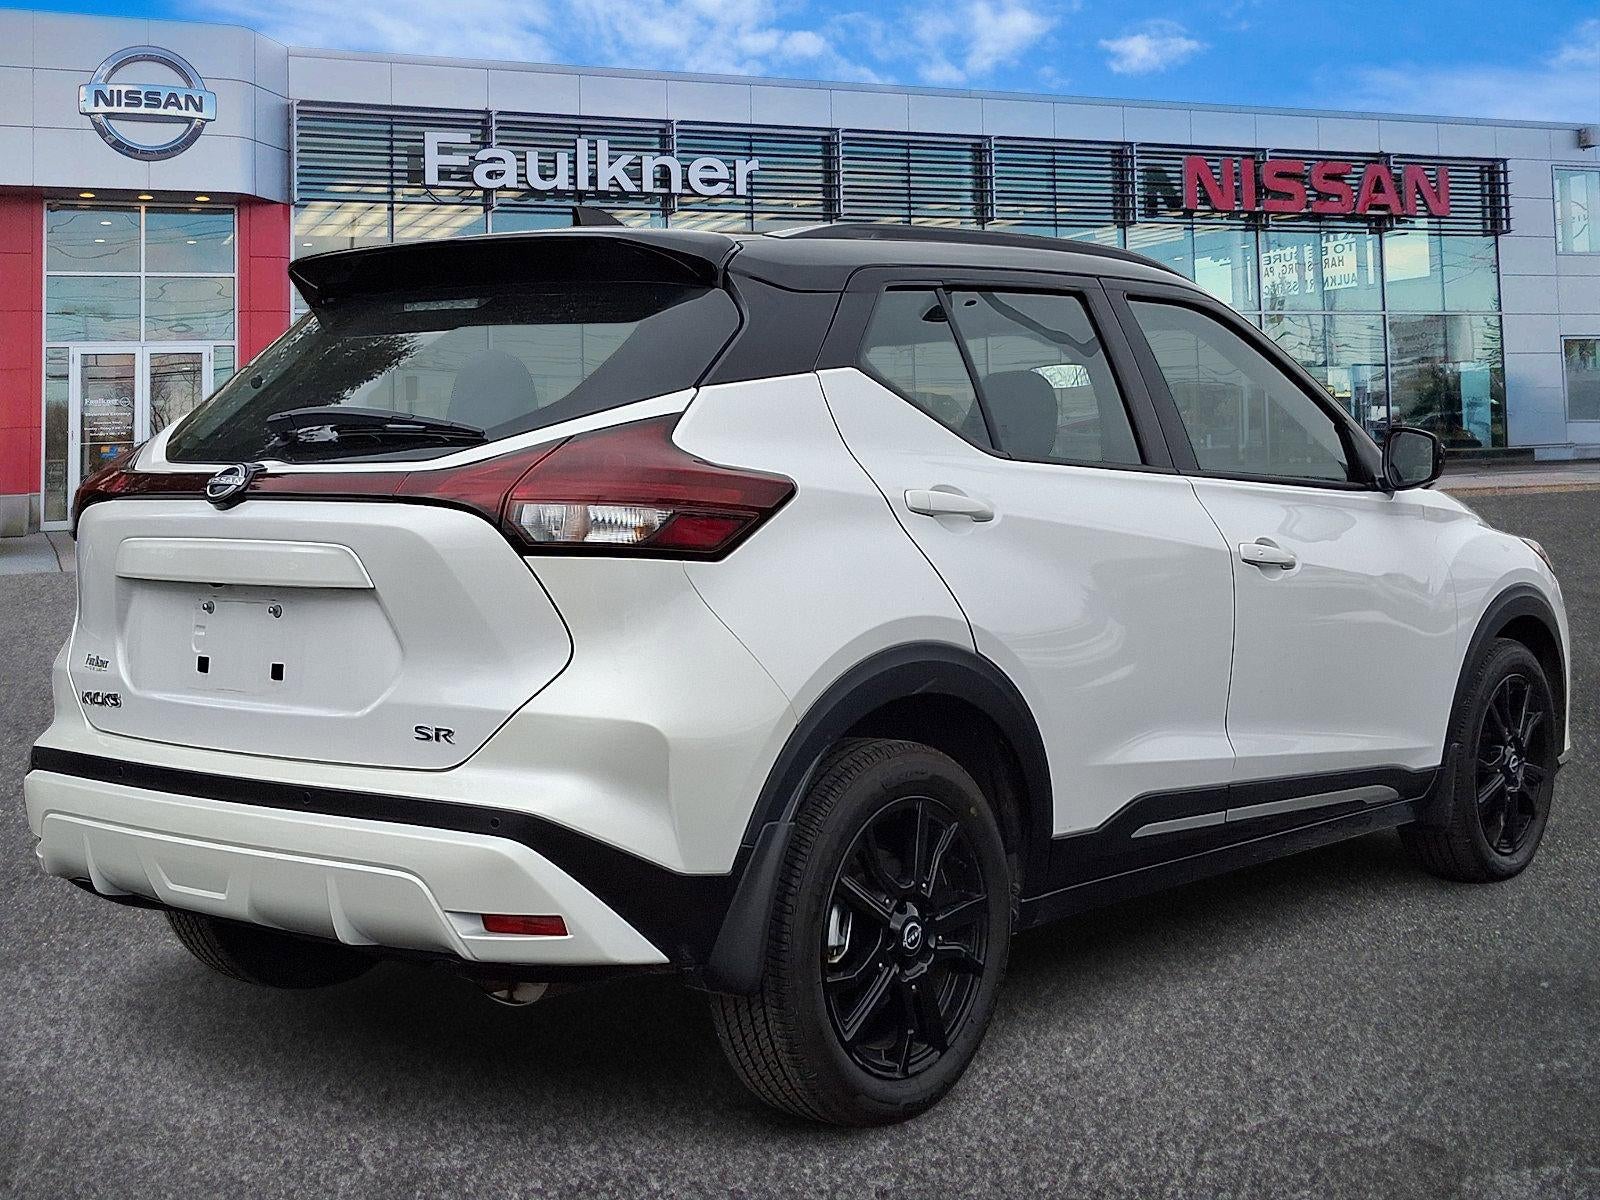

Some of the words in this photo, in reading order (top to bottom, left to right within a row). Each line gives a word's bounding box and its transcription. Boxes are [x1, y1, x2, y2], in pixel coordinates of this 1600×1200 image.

[94, 89, 204, 113] NISSAN
[423, 131, 760, 196] Faulkner
[1182, 155, 1451, 216] NISSAN
[81, 690, 122, 708] KICKS
[414, 725, 455, 745] SR
